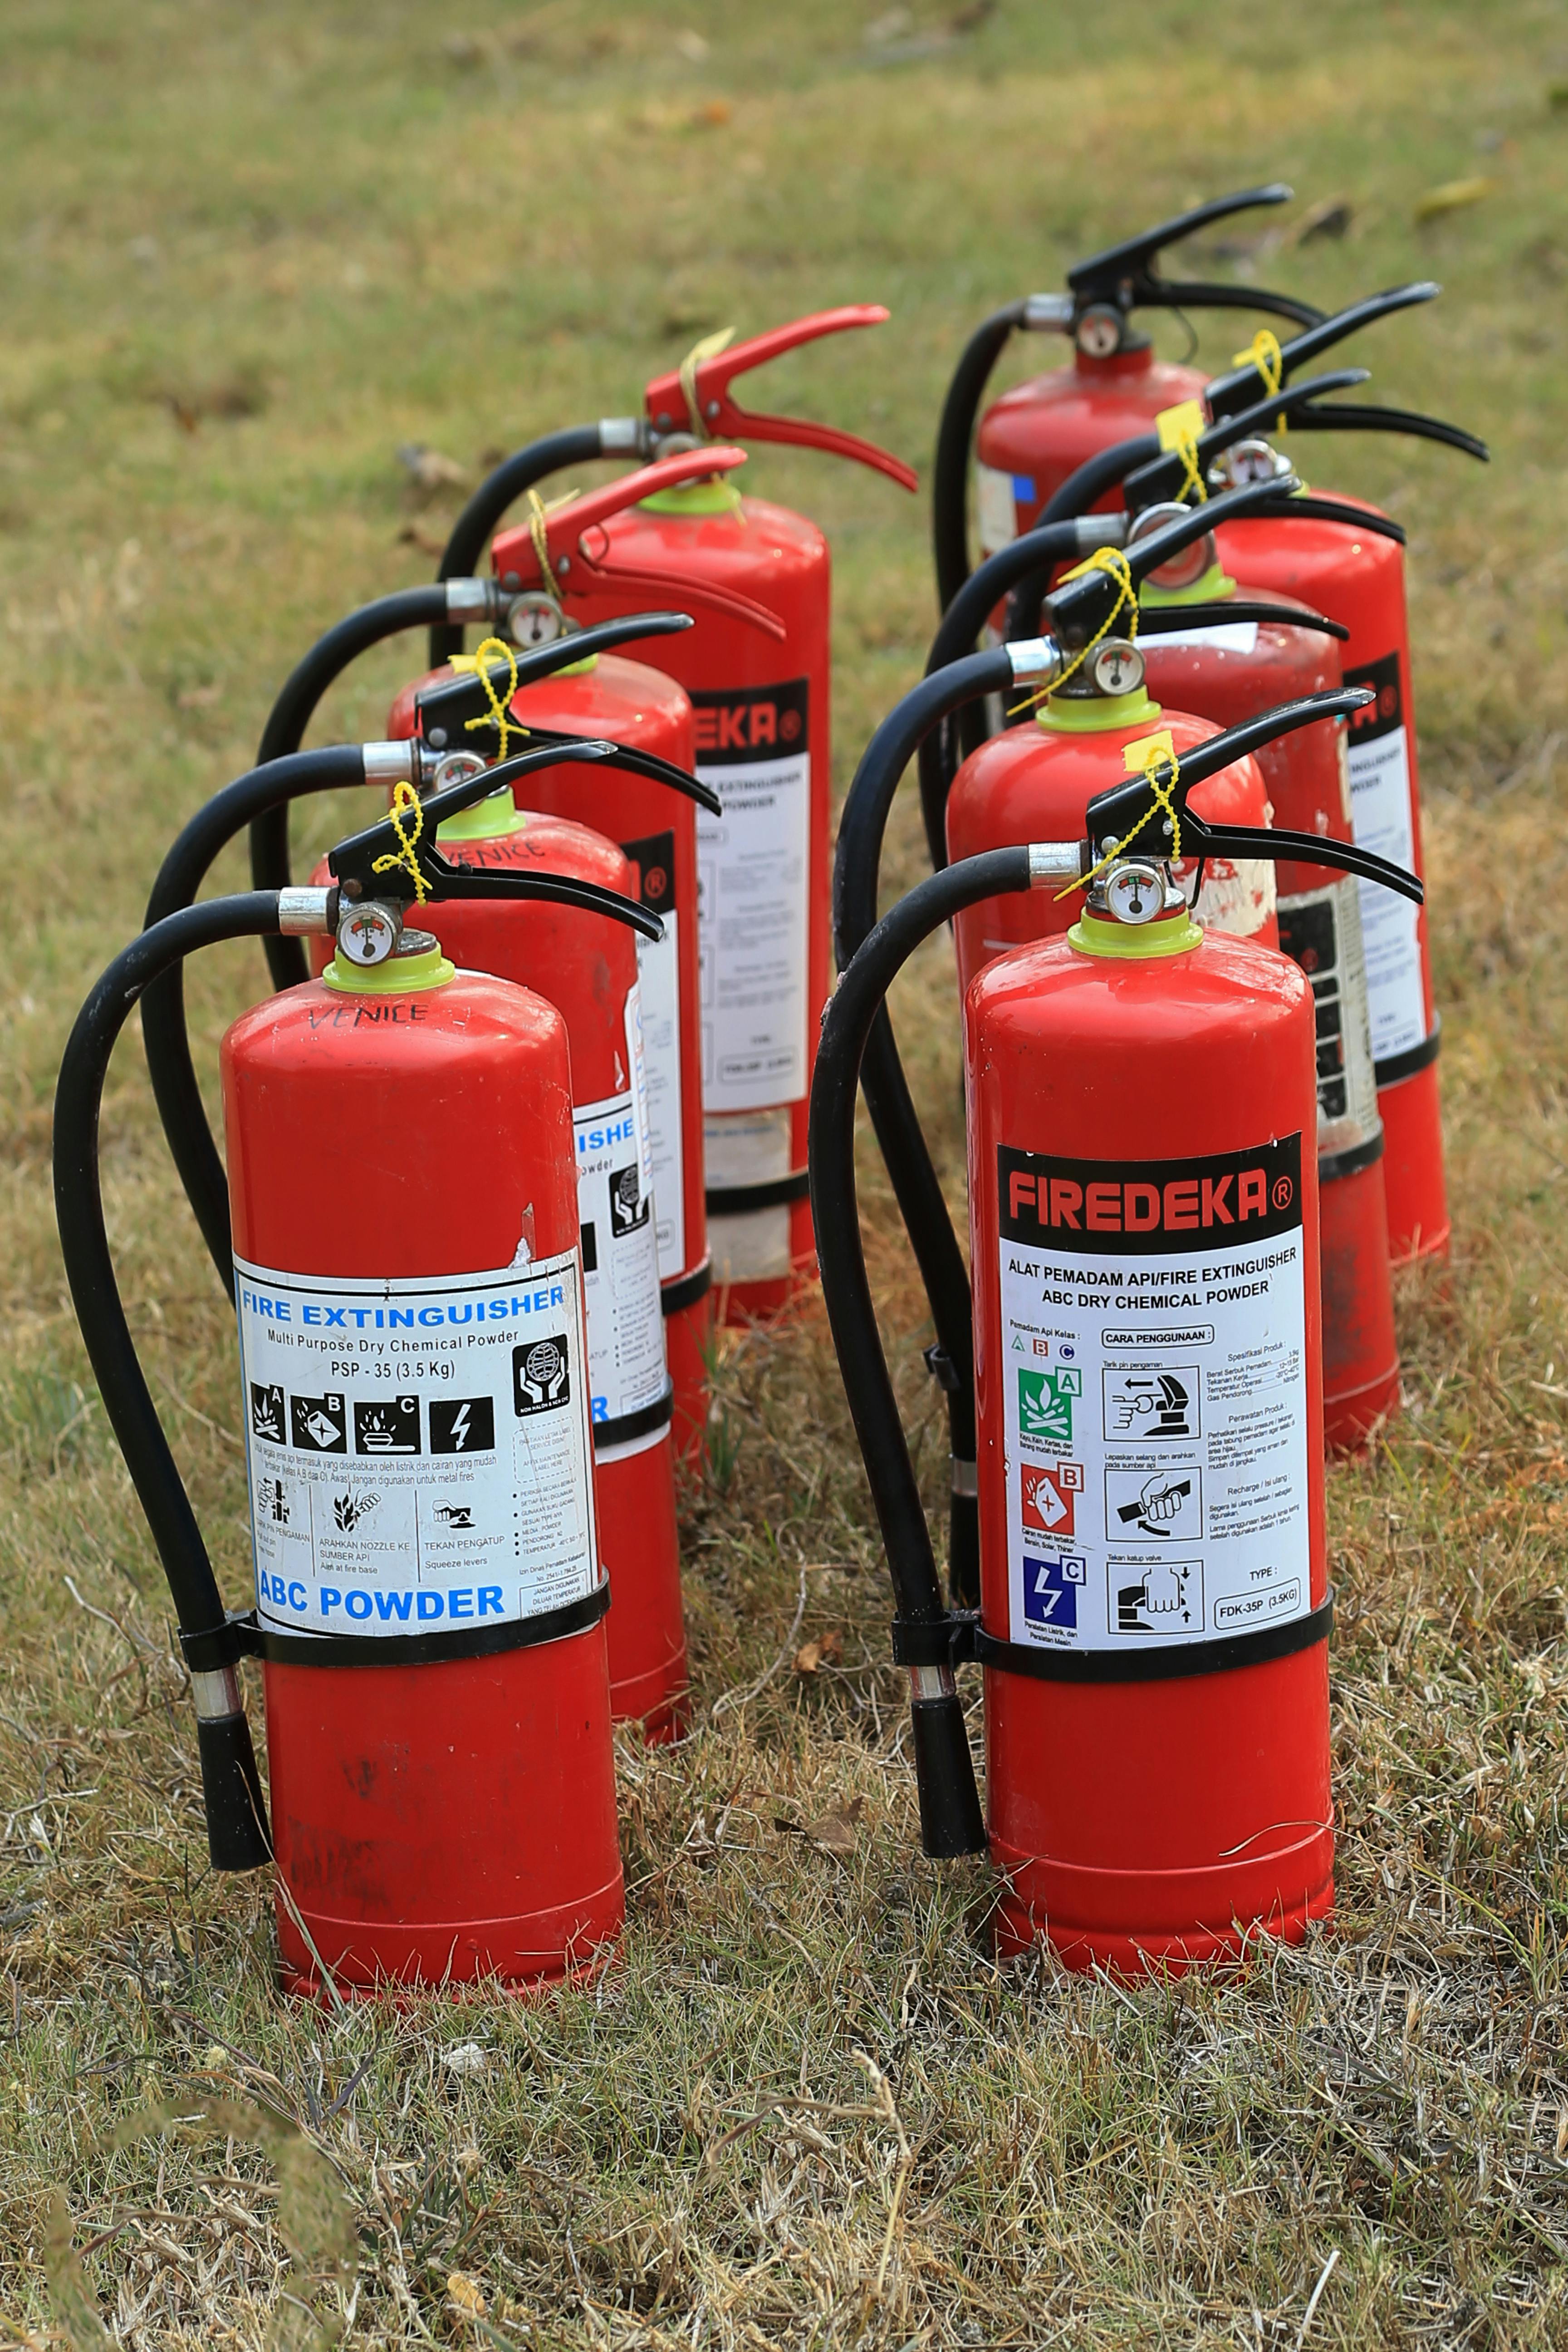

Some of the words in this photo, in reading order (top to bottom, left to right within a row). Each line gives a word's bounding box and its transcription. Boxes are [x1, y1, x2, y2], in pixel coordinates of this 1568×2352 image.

[309, 1004, 428, 1029] VENICE
[582, 1159, 612, 1176] owder
[1009, 1259, 1040, 1277] ALAT
[1044, 1266, 1122, 1286] PEMADAM
[1127, 1270, 1197, 1286] API/FIRE
[1202, 1247, 1296, 1282] EXTINGUISHER
[1042, 1290, 1073, 1306] ABC
[1078, 1294, 1111, 1308] DRY
[1115, 1293, 1202, 1309] CHEMICAL
[1207, 1280, 1269, 1304] POWDER
[243, 1289, 291, 1322] FIRE
[302, 1285, 564, 1328] EXTINGUISHER
[1010, 1318, 1039, 1334] Pemadam
[1041, 1328, 1053, 1337] Api
[1055, 1329, 1075, 1339] Kelas
[268, 1328, 294, 1346] Multi
[298, 1335, 353, 1352] Purpose
[359, 1340, 384, 1355] Dry
[390, 1336, 462, 1352] Chemical
[467, 1331, 519, 1347] Powder
[1106, 1334, 1133, 1343] CARA
[1136, 1330, 1205, 1343] PENGGUNAAN
[1228, 1348, 1262, 1362] Spesifikasi
[332, 1361, 359, 1377] PSP
[374, 1363, 391, 1378] 35
[397, 1361, 424, 1382] (3.5
[430, 1360, 455, 1380] Kg)
[1061, 1374, 1076, 1392] A
[272, 1388, 282, 1403] A
[328, 1396, 341, 1411] B
[401, 1398, 415, 1413] C
[1229, 1409, 1263, 1423] Perawatan
[296, 1455, 321, 1467] termasuk
[323, 1460, 338, 1472] yang
[340, 1460, 377, 1471] disebabkan
[380, 1461, 394, 1471] oleh
[396, 1461, 415, 1471] listrik
[416, 1461, 430, 1470] dan
[432, 1460, 453, 1470] cairan
[455, 1459, 472, 1471] yang
[474, 1455, 496, 1467] mudah
[352, 1475, 377, 1486] Jangan
[378, 1475, 415, 1487] digunakan
[416, 1475, 436, 1485] untuk
[438, 1473, 457, 1483] metal
[459, 1471, 474, 1481] fires
[1064, 1470, 1077, 1485] B
[1227, 1484, 1259, 1495] Recharge
[275, 1527, 310, 1542] PENGAMAN
[319, 1539, 358, 1549] ARAHKAN
[360, 1542, 396, 1551] NOZZLE
[398, 1543, 410, 1551] KE
[425, 1542, 455, 1550] TEKAN
[457, 1535, 505, 1548] PENGATUP
[320, 1550, 353, 1561] SUMBER
[356, 1553, 370, 1561] API
[344, 1564, 357, 1573] fire
[359, 1566, 378, 1574] base
[425, 1561, 461, 1570] Squeeze
[464, 1558, 488, 1566] levers
[1065, 1563, 1079, 1579] C
[1250, 1567, 1272, 1581] TYPE
[260, 1569, 308, 1612] ABC
[319, 1585, 505, 1621] POWDER
[1220, 1600, 1263, 1617] FDK-35P
[1269, 1588, 1297, 1610] (3.5KG)
